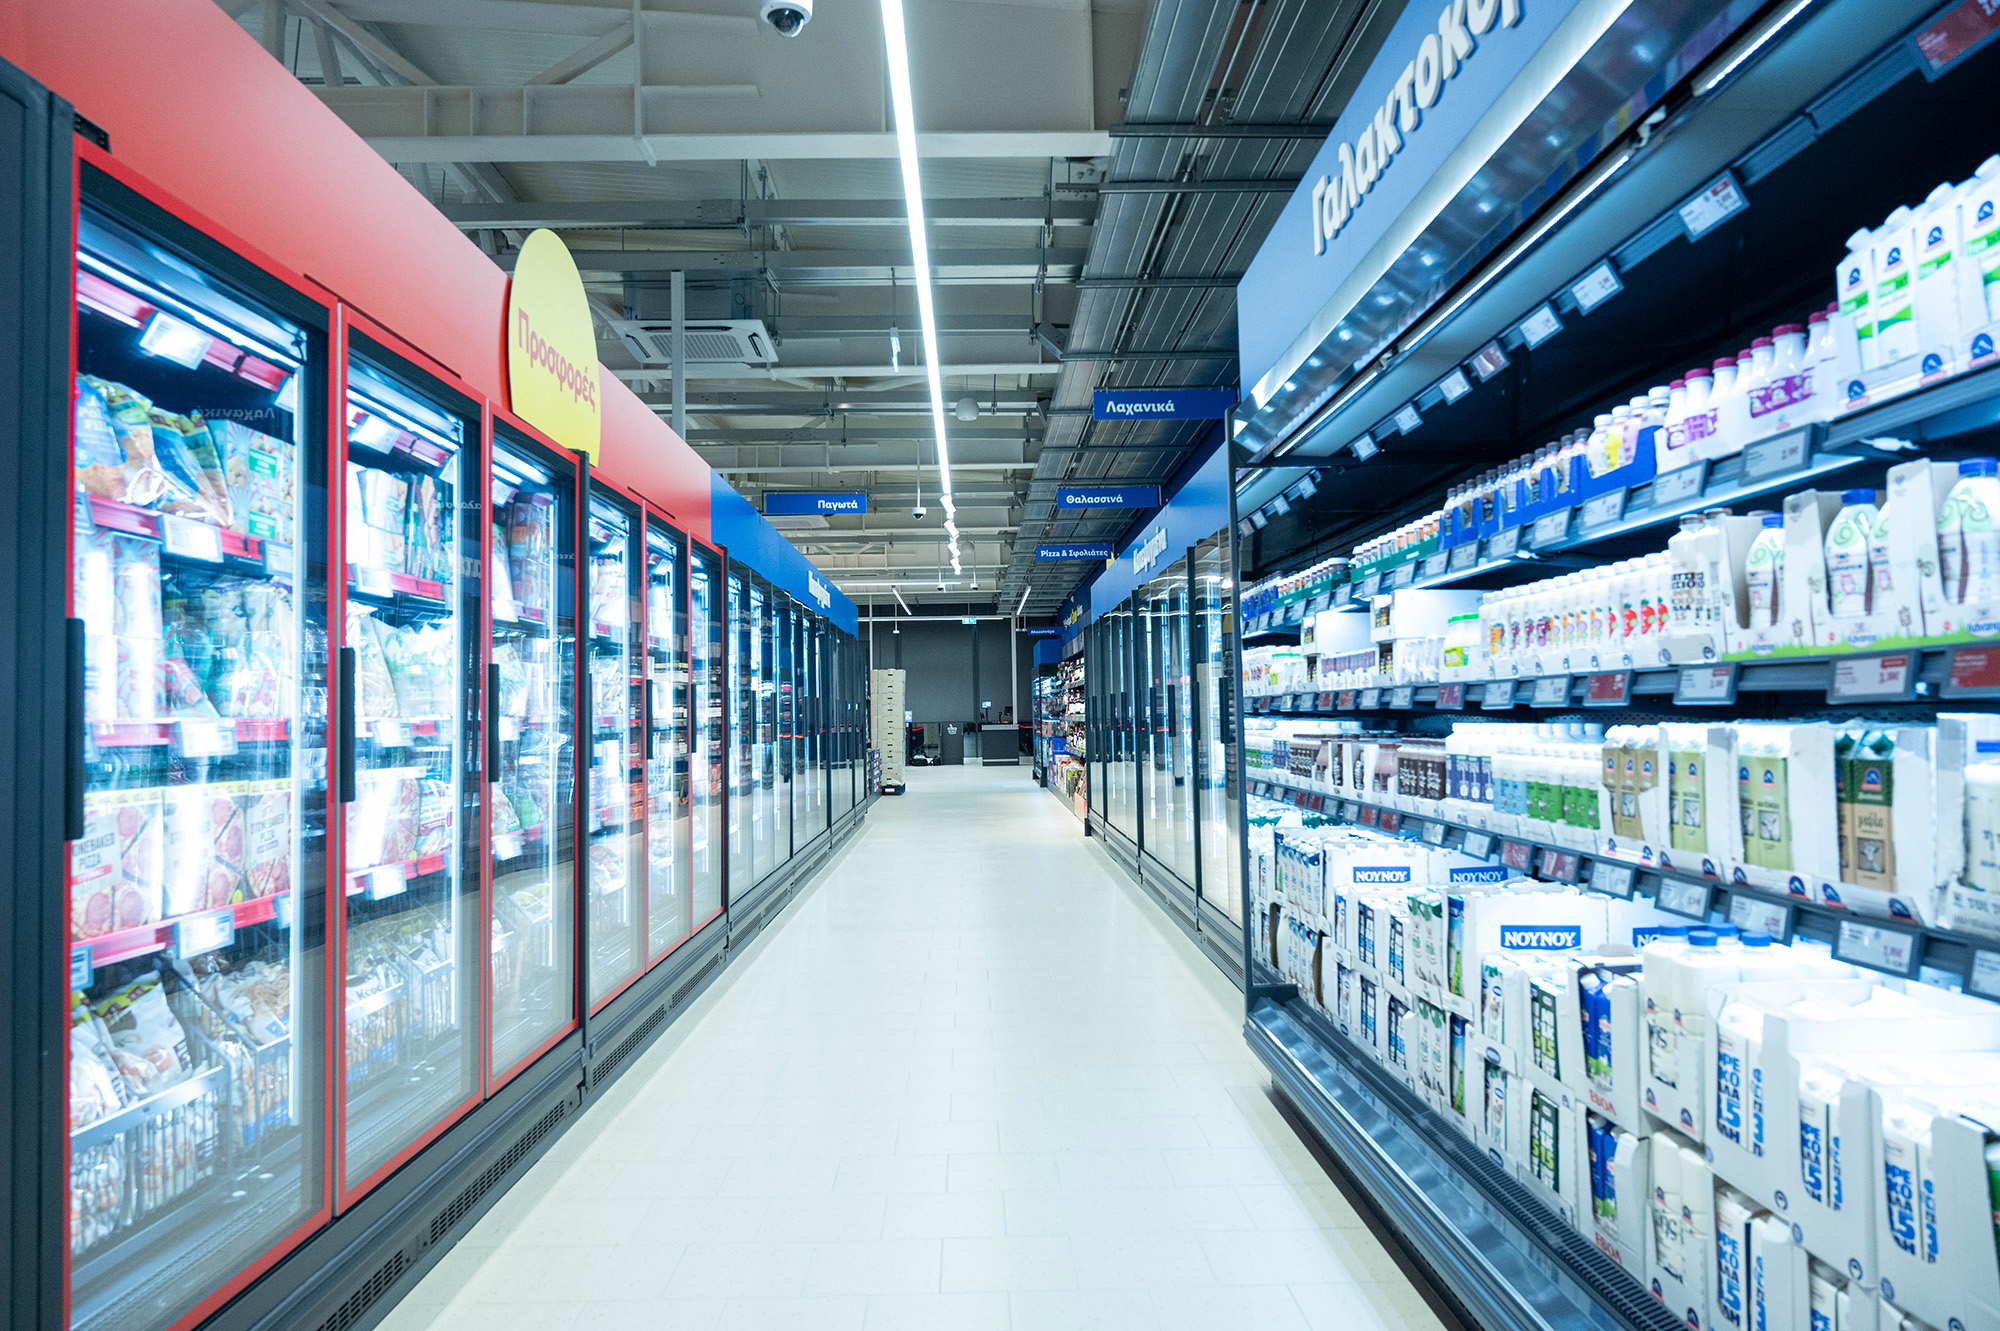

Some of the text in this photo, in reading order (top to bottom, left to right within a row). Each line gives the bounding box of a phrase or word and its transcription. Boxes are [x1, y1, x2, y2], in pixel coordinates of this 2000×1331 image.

[518, 307, 596, 413] Προσφορές
[1106, 400, 1176, 416] Λαχανικά
[1065, 494, 1124, 504] Θαλασσινά
[817, 500, 859, 511] Παγωτά
[1040, 548, 1108, 559] Pizza & Σφολιάτες
